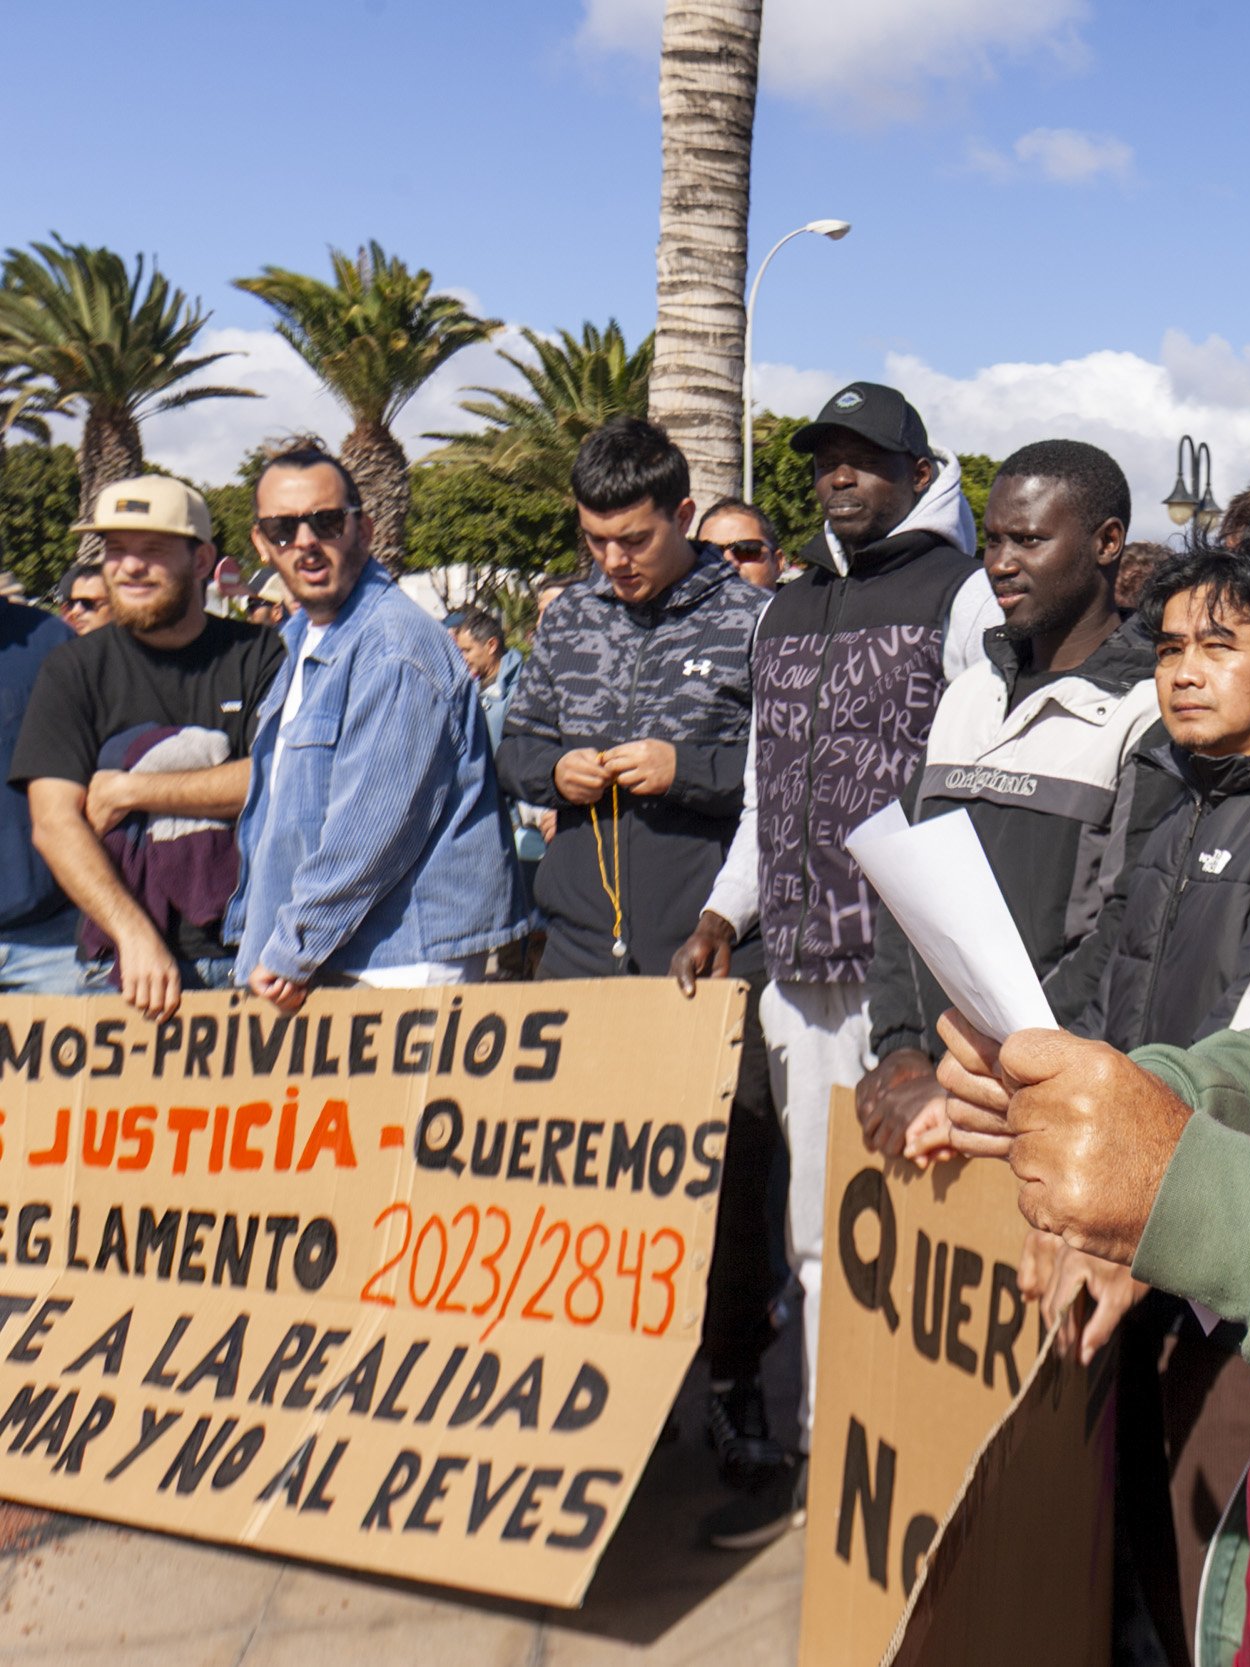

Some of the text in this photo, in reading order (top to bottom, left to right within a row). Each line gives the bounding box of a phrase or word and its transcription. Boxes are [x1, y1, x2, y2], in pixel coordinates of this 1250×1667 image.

[360, 1202, 687, 1342] 2023/2843
[838, 1167, 1049, 1401] QUER
[60, 1306, 134, 1376] A
[141, 1313, 257, 1399] LA
[247, 1321, 611, 1433] REALIDAD
[0, 1383, 625, 1551] MAR Y NO AL REVES
